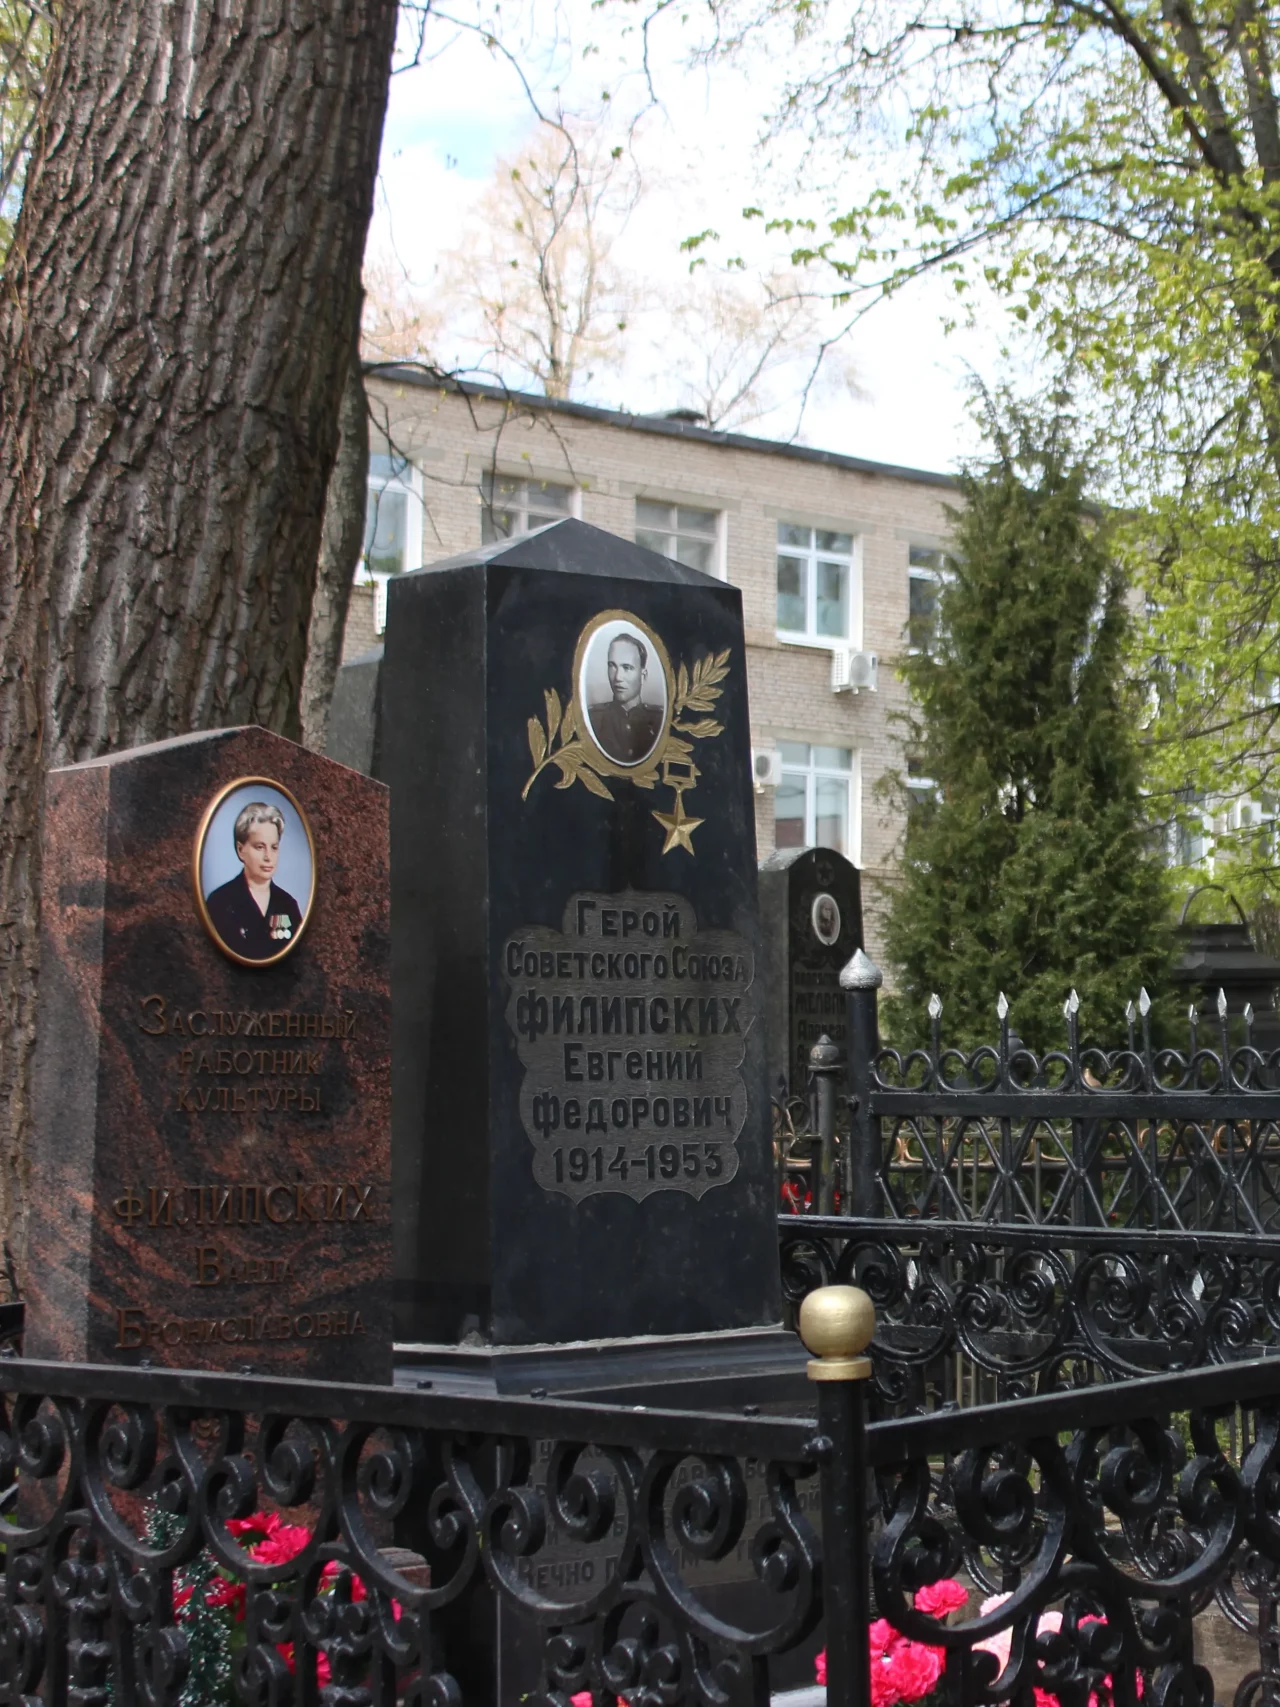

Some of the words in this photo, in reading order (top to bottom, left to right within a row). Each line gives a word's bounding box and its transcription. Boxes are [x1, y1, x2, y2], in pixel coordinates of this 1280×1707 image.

[515, 988, 742, 1042] ФИЛИПСКИХ
[176, 1049, 322, 1075] РАБОТНИК
[175, 1086, 321, 1112] КУЛЬТУРЫ
[113, 1184, 376, 1228] ФИЛИПСКИХ
